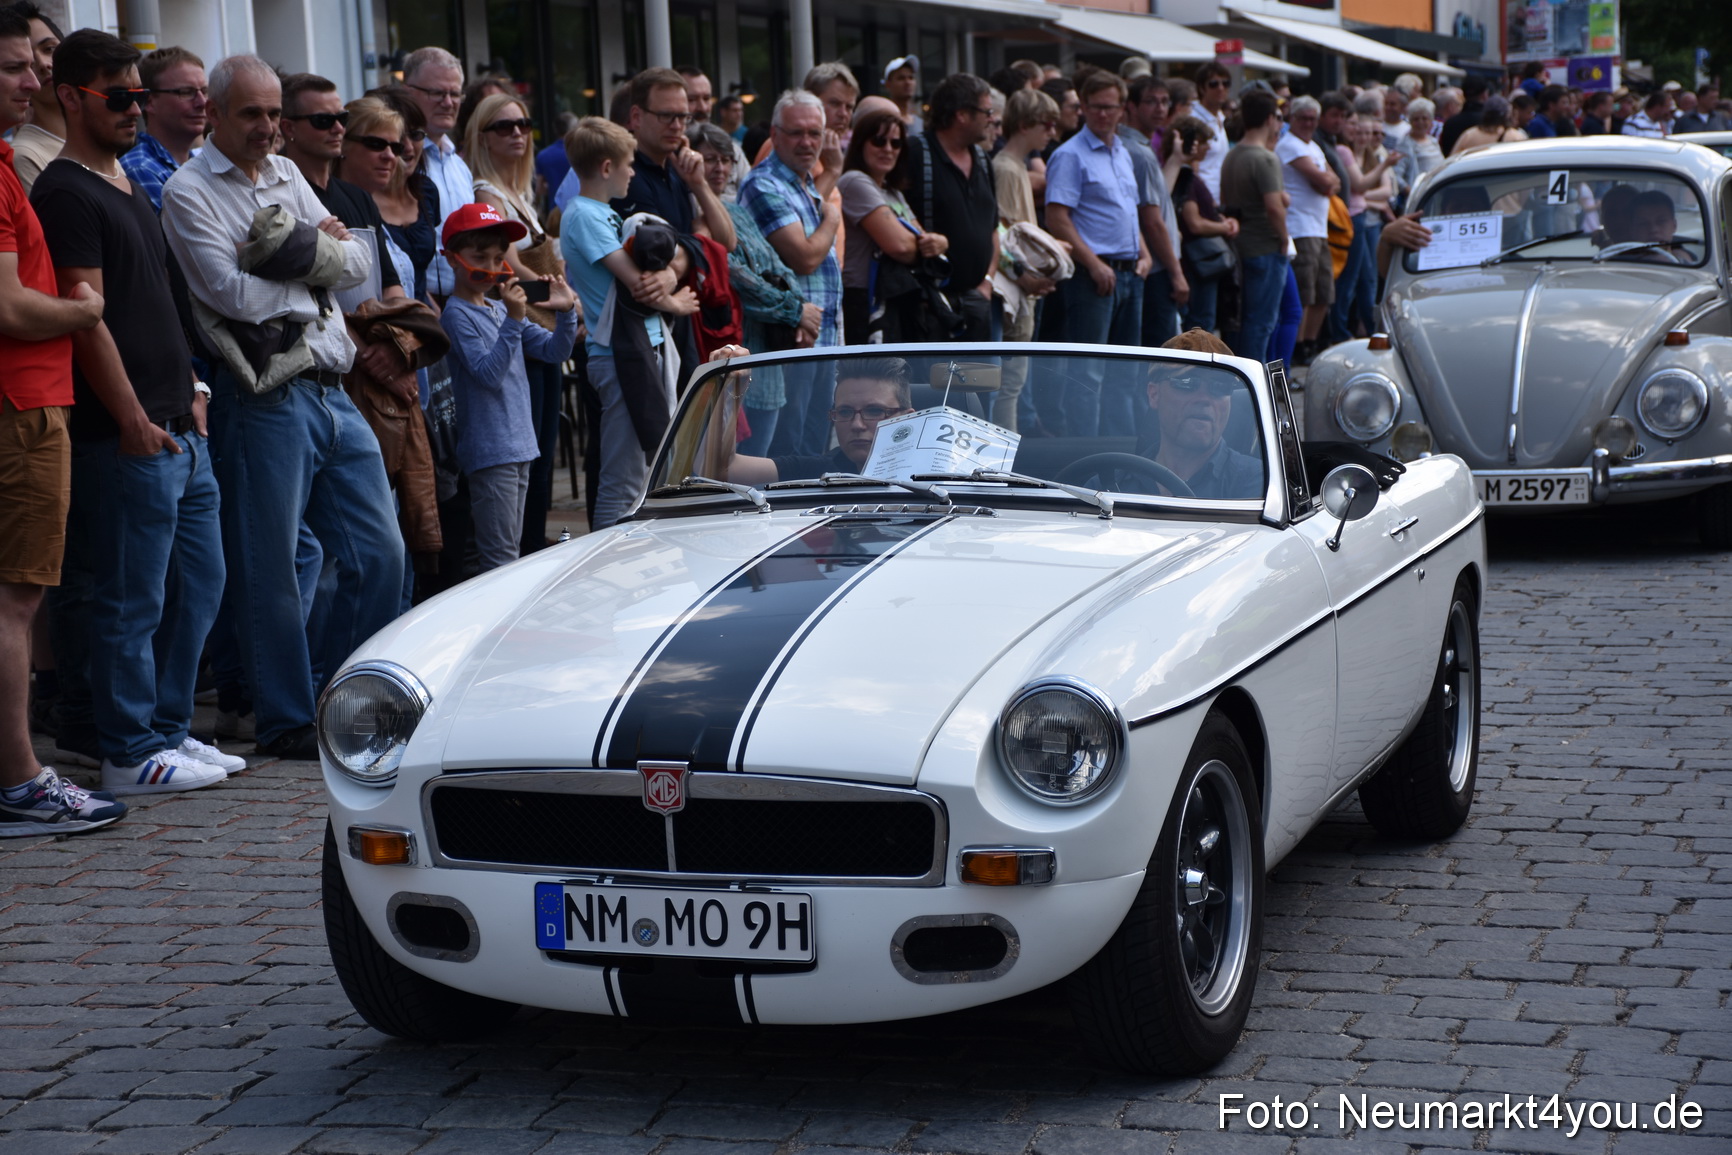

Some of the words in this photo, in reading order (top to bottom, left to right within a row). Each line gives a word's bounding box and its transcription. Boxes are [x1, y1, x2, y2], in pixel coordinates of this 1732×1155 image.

[1550, 173, 1567, 202] 4
[1459, 222, 1488, 236] 515
[935, 423, 991, 456] 287
[1508, 478, 1572, 501] 2597
[651, 775, 676, 802] MG
[546, 923, 557, 937] D
[564, 893, 628, 943] NM
[664, 897, 729, 947] MO
[743, 901, 809, 951] 9H
